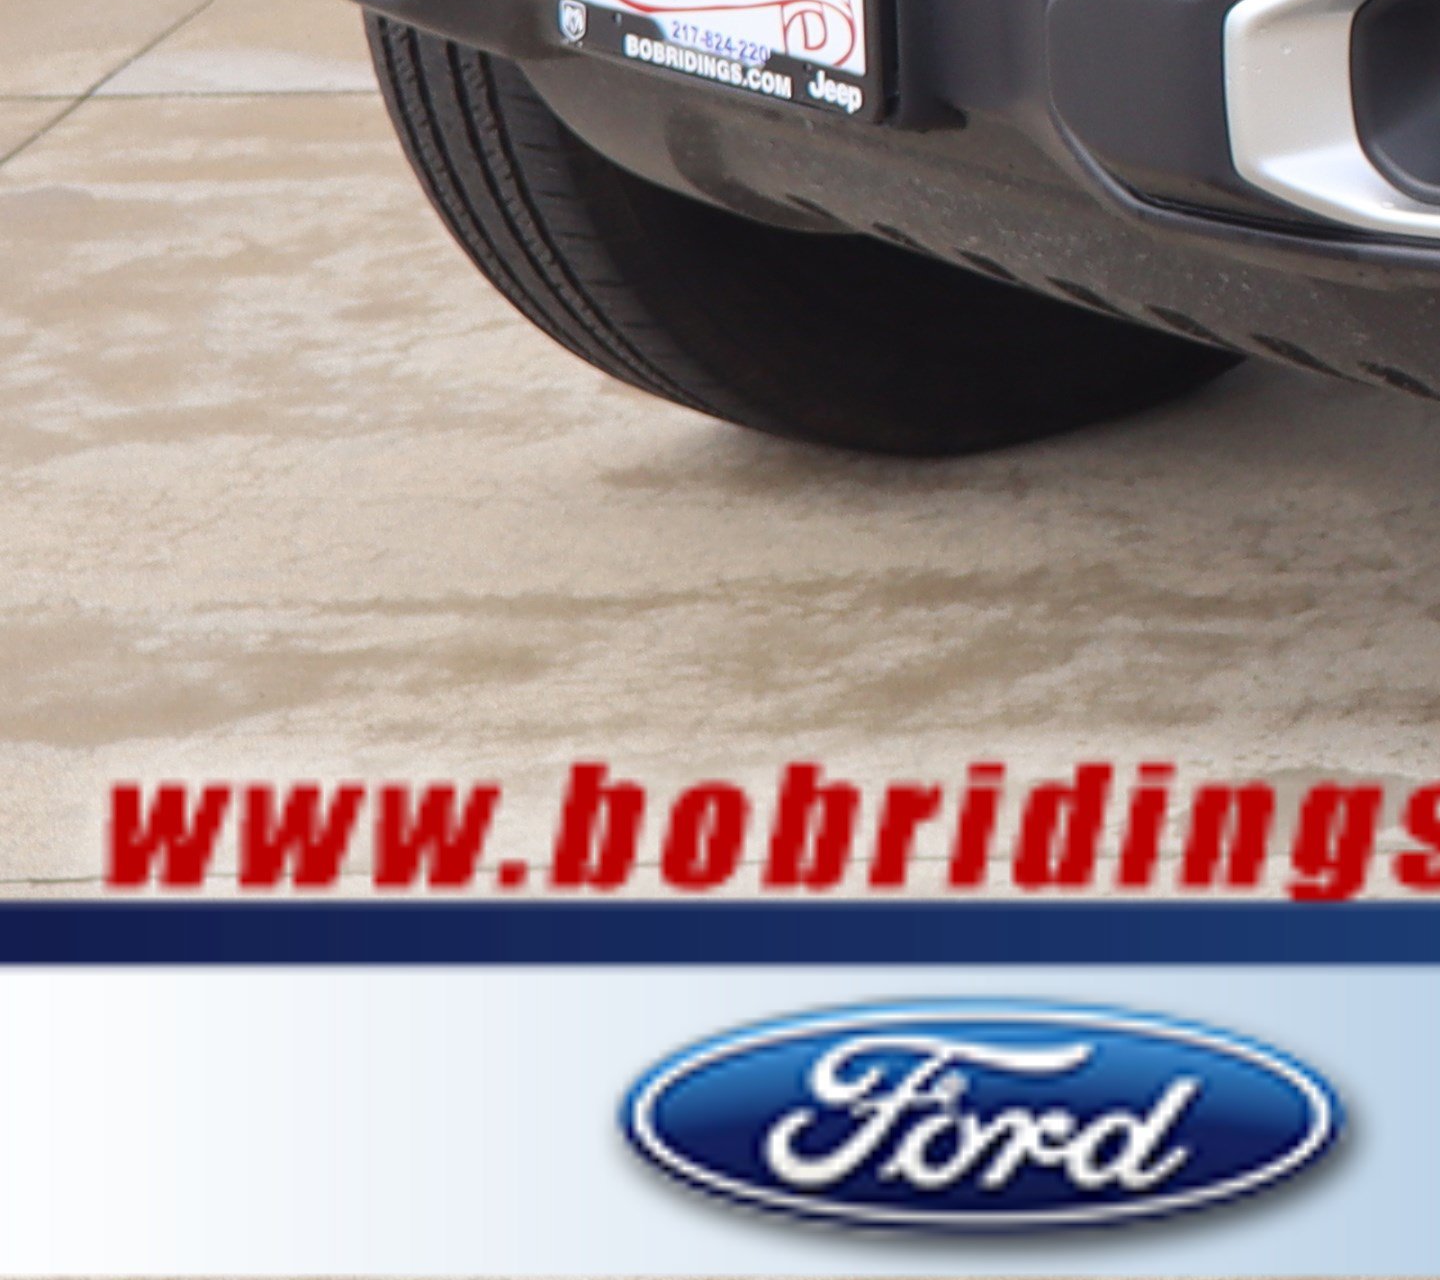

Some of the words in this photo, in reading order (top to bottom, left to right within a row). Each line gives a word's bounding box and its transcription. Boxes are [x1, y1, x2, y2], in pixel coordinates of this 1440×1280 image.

[623, 34, 793, 100] BOBRIDINGS.COM
[671, 20, 776, 67] 217-824-220
[807, 70, 864, 115] Jeep
